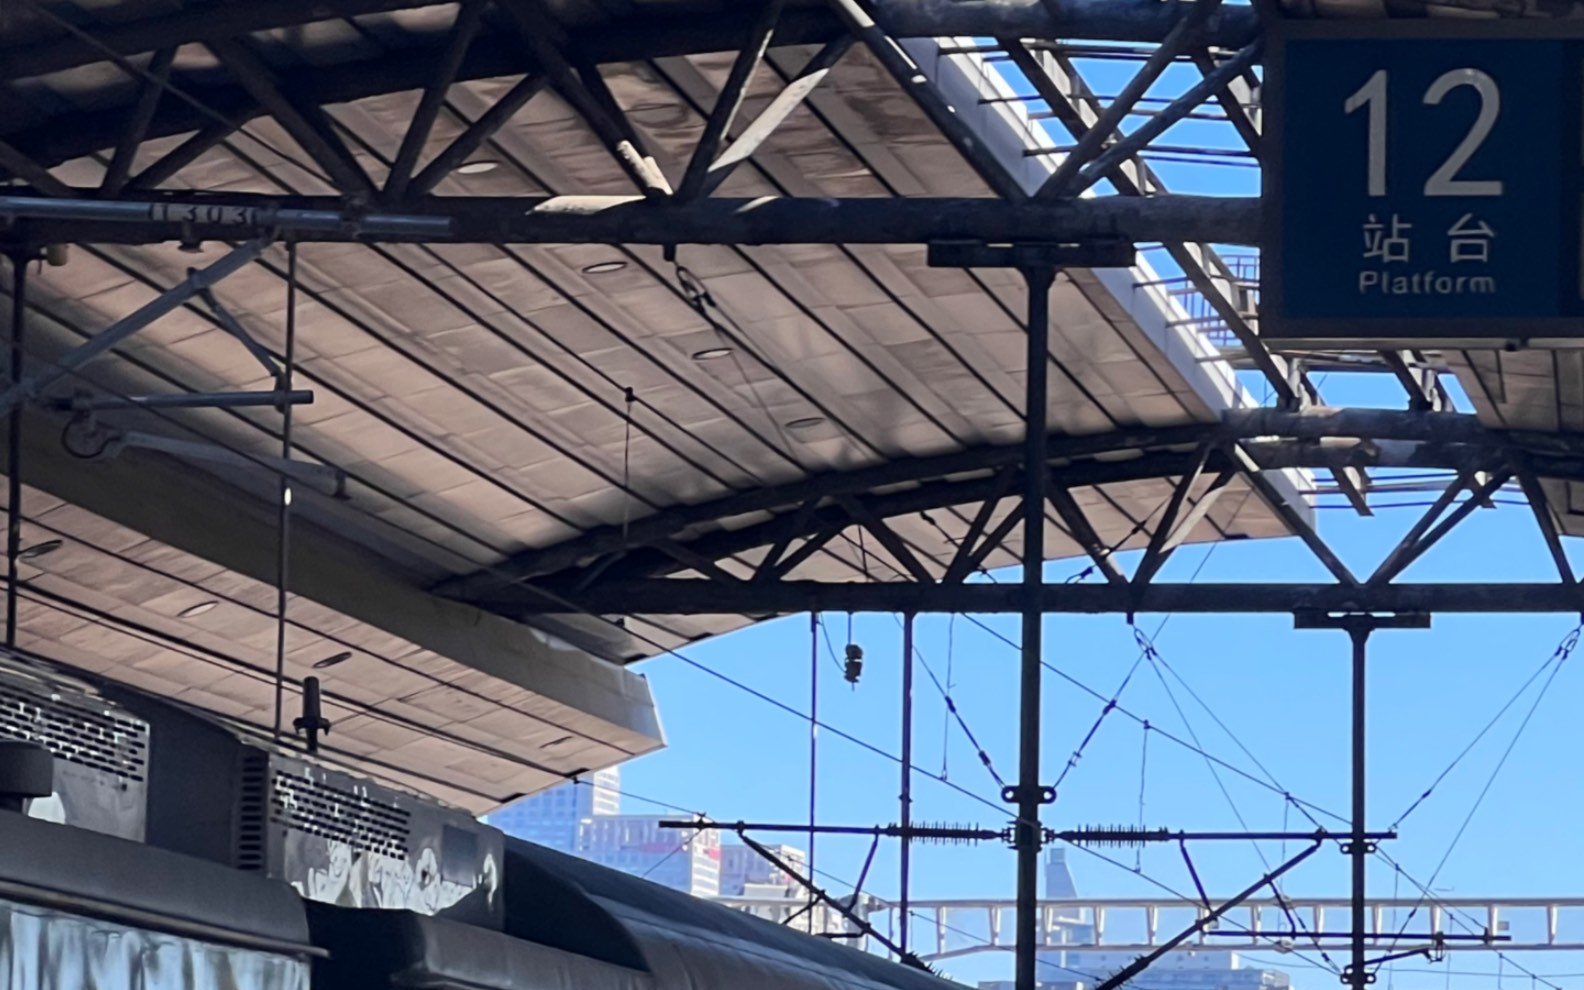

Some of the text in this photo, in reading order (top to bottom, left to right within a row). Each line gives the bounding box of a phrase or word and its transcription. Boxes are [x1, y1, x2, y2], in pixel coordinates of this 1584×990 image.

[1344, 67, 1503, 197] 12
[1363, 214, 1495, 263] 站台
[1360, 271, 1495, 294] Platform
